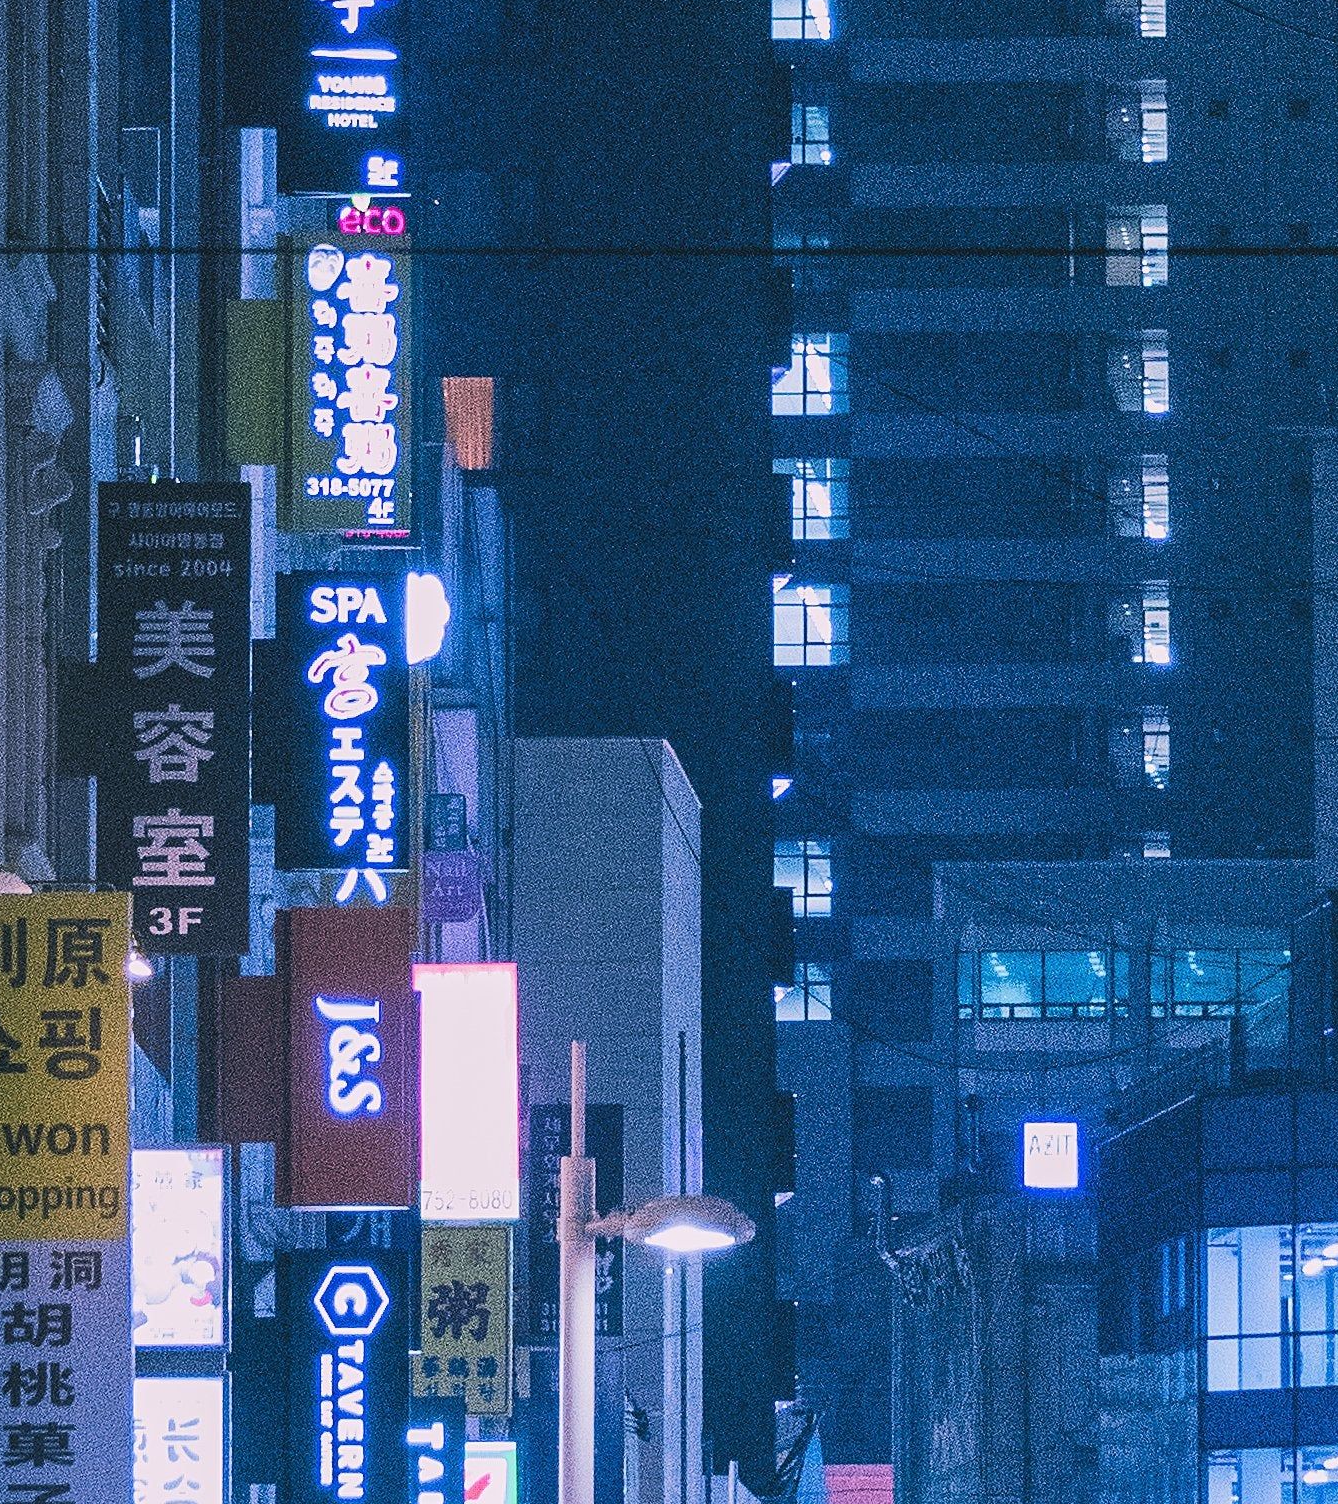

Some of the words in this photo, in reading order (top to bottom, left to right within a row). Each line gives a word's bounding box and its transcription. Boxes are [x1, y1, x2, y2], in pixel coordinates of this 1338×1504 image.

[327, 113, 378, 130] HOTEL
[306, 477, 396, 499] 318-5077
[112, 557, 172, 578] since
[310, 587, 387, 624] SPA
[131, 599, 217, 888] 美容室
[329, 727, 365, 848] エステ
[147, 907, 205, 937] 3F
[315, 996, 382, 1115] J&S
[0, 1117, 110, 1158] won
[336, 1339, 365, 1499] TAVERN
